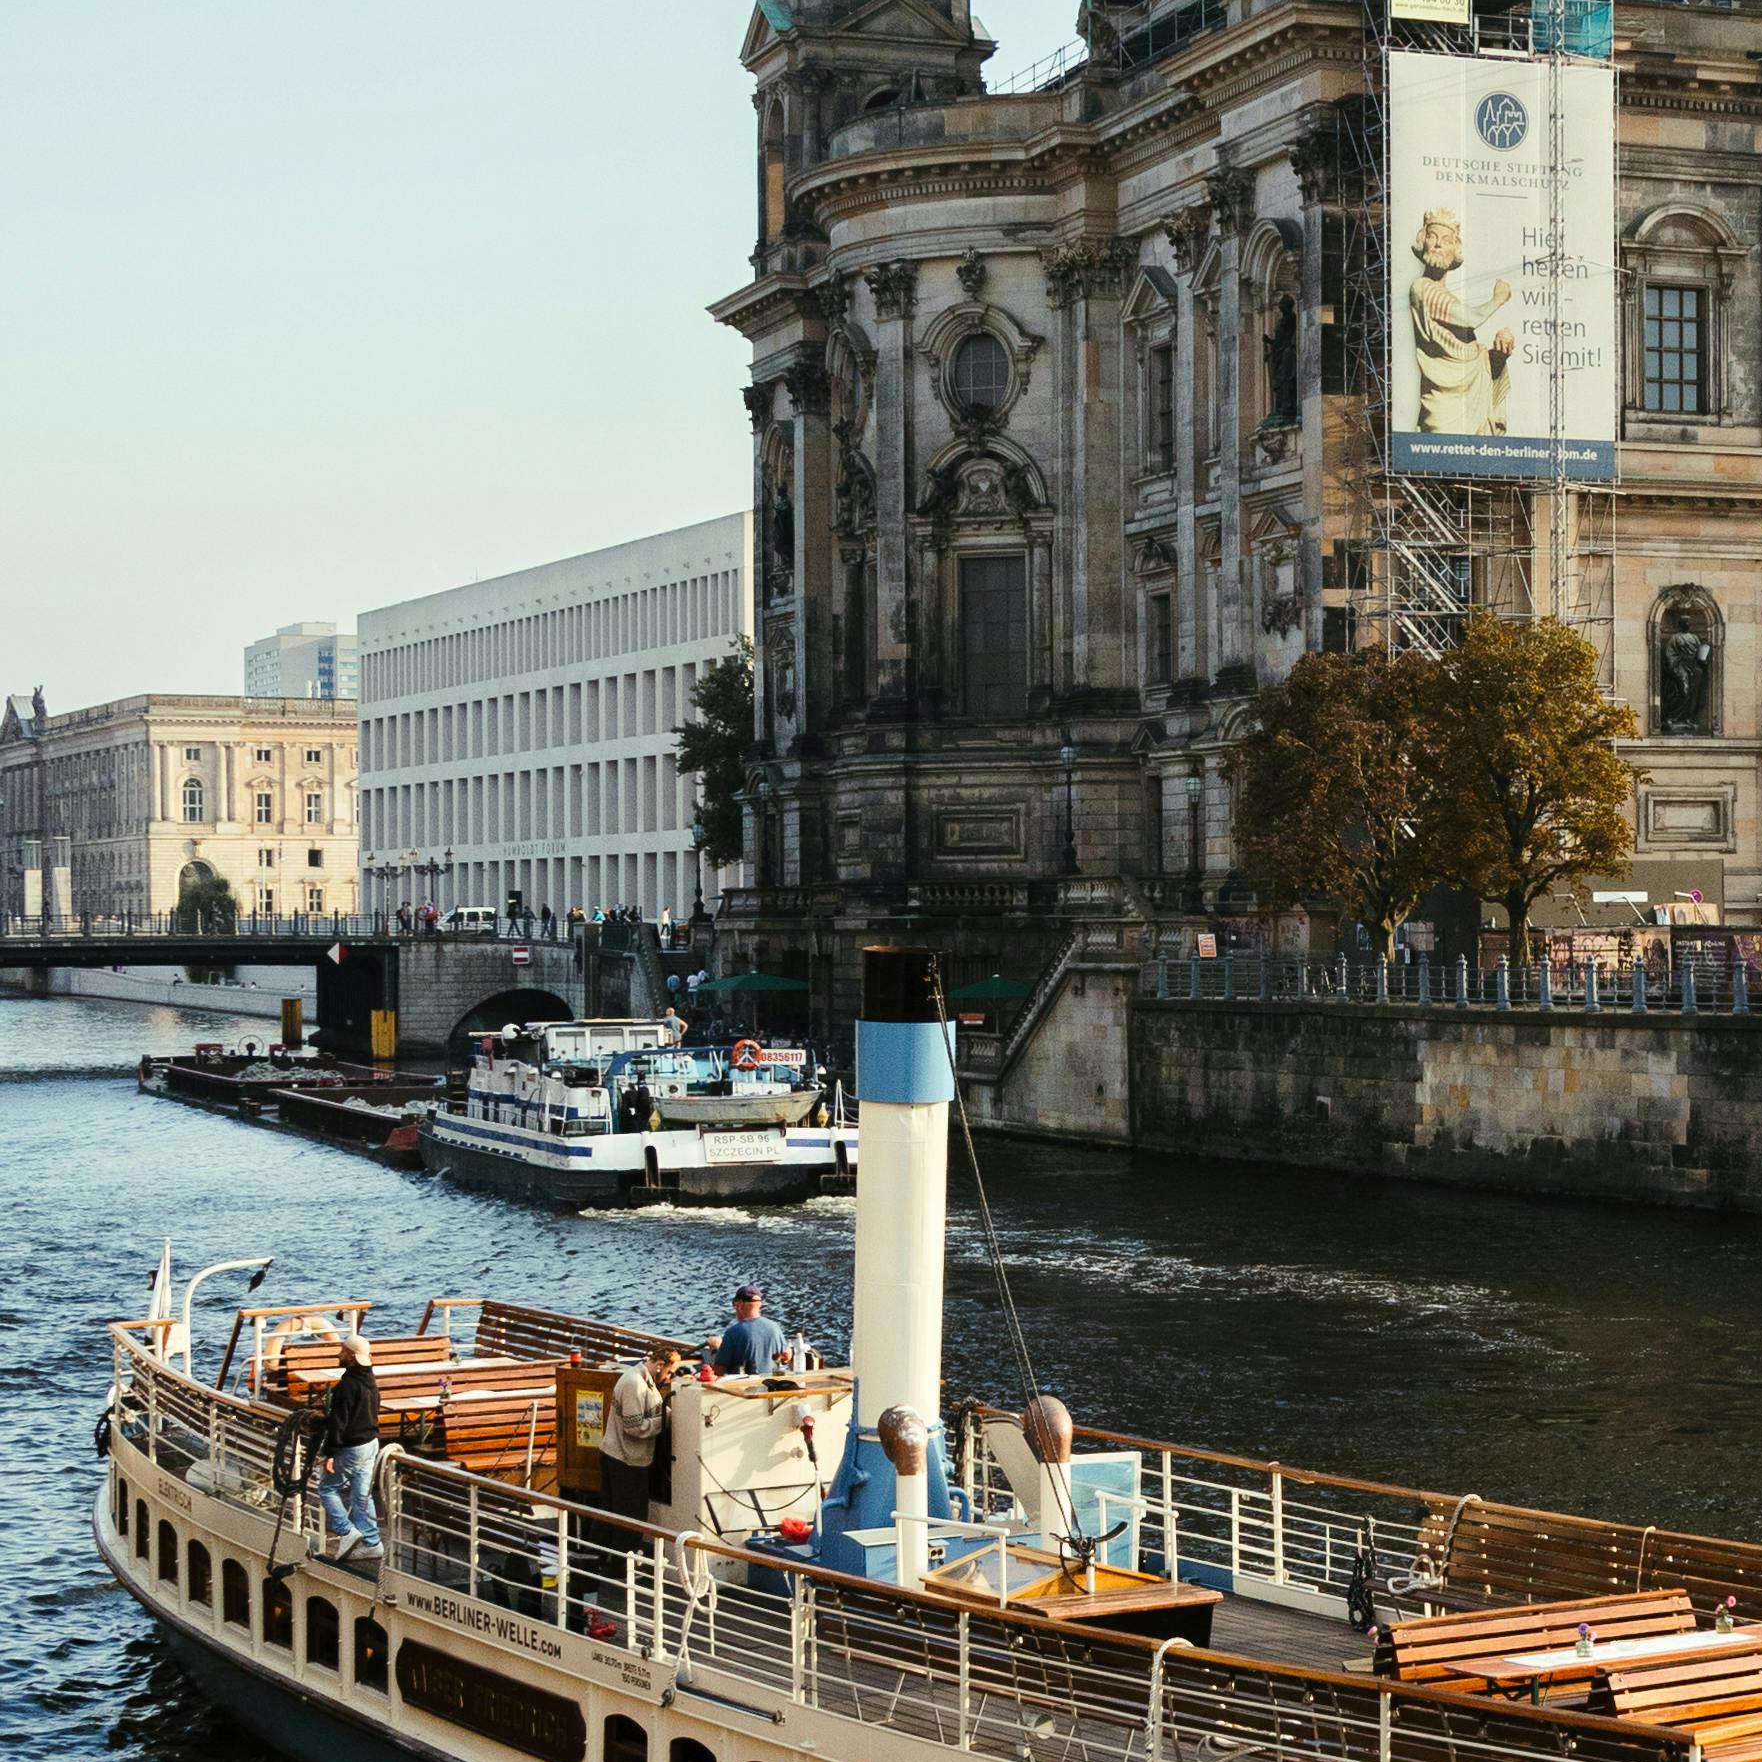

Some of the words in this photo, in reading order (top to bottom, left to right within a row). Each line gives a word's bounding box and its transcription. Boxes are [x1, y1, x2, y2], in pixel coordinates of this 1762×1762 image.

[1423, 156, 1501, 172] DEUTSCHE
[1506, 162, 1583, 178] STIFTNG
[1522, 255, 1589, 280] heen
[1522, 343, 1552, 366] Sie
[1560, 346, 1601, 368] mit!
[542, 841, 566, 855] FORUM
[761, 1052, 803, 1062] 08356117
[713, 1134, 755, 1144] RSP-SB
[757, 1133, 770, 1144] 96
[709, 1147, 764, 1158] SZCZECIN
[766, 1146, 780, 1156] PL
